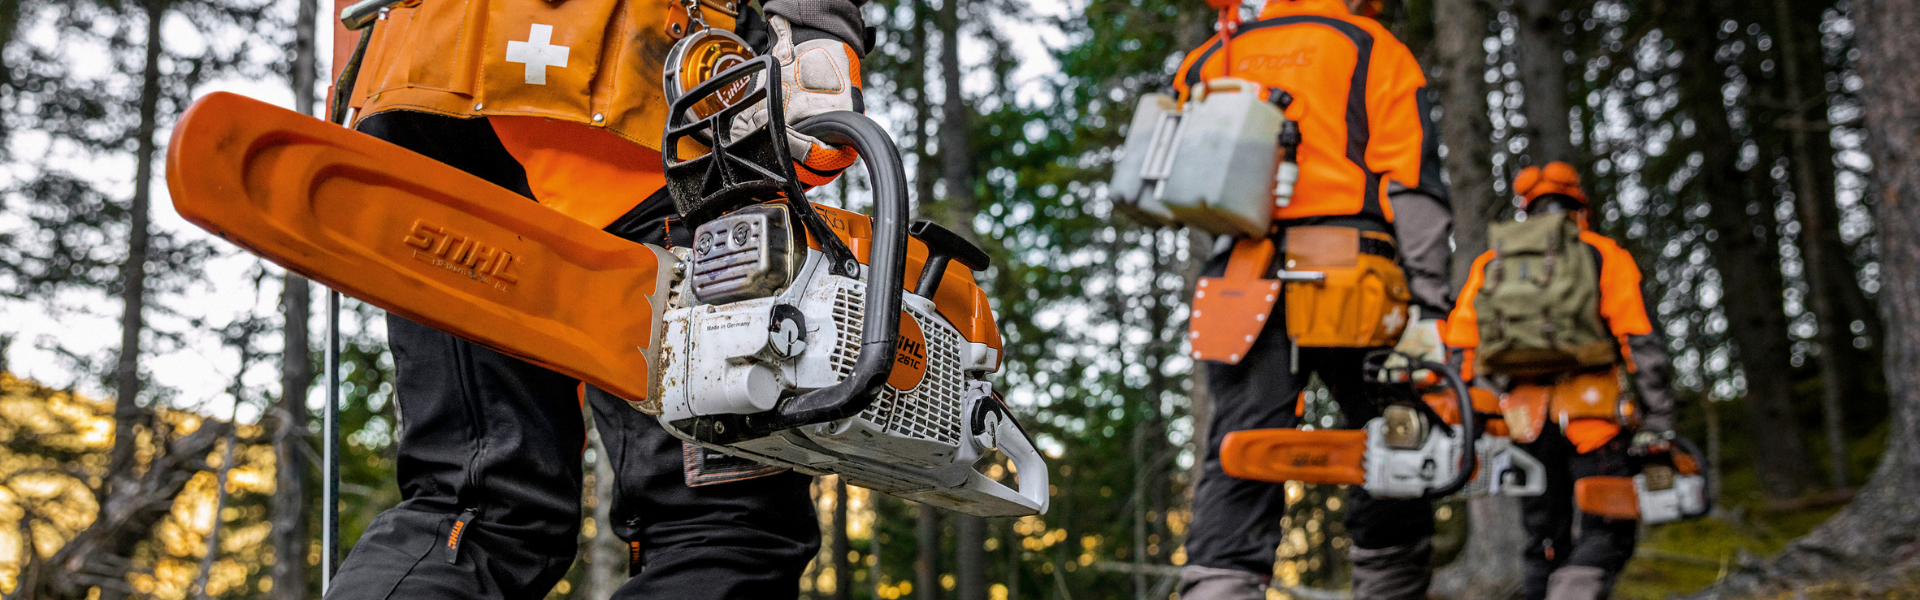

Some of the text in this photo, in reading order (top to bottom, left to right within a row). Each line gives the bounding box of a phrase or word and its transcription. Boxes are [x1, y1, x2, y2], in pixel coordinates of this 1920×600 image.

[403, 219, 518, 286] STIHL
[897, 335, 923, 360] IHL
[897, 353, 921, 370] 261C
[448, 520, 464, 547] STIHL
